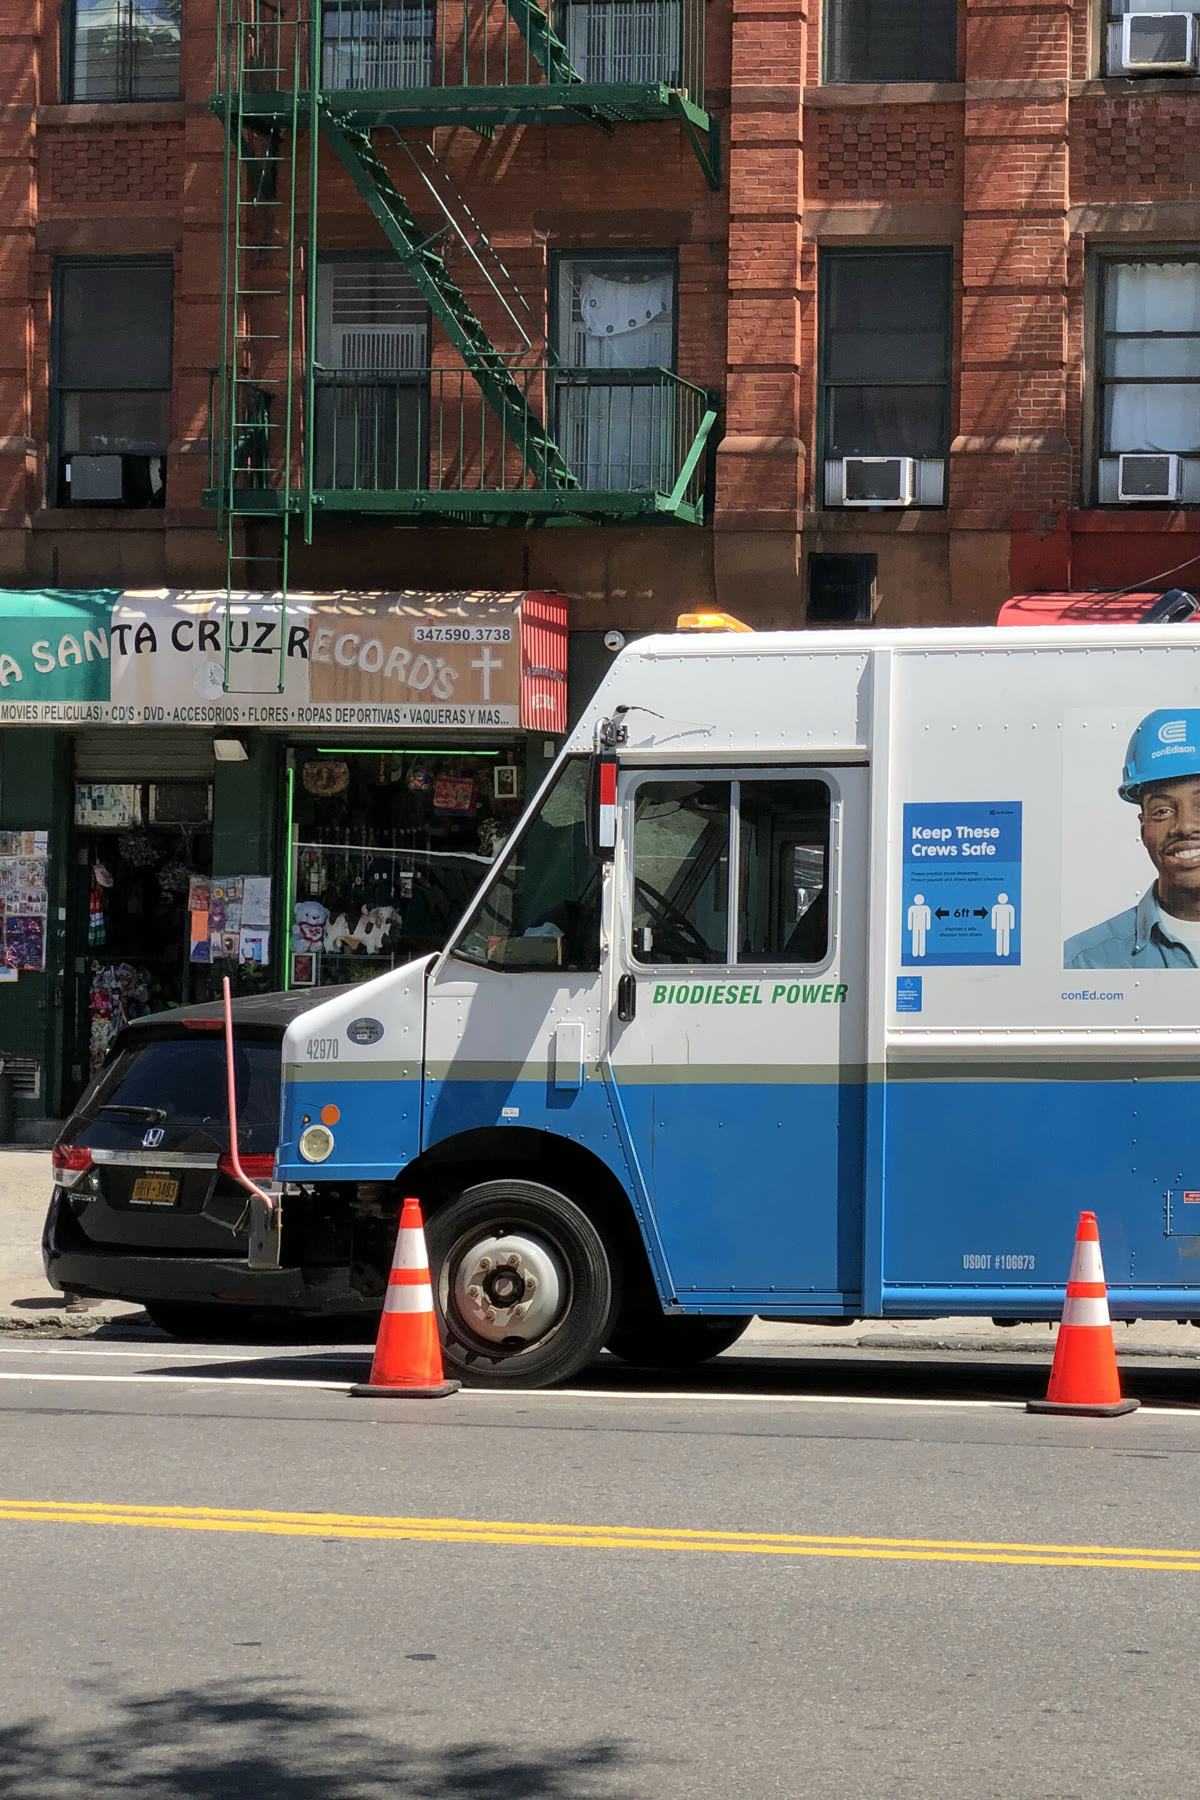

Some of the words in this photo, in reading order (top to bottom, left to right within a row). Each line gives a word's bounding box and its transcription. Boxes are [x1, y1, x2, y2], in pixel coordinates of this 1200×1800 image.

[416, 628, 511, 642] 347.590.3738
[32, 621, 157, 674] SANTA
[171, 620, 277, 655] CRUZ
[287, 625, 459, 700] RECORD'S
[1, 704, 39, 720] MOVIES
[40, 704, 103, 722] (PELICULAS)
[111, 705, 135, 721] CD'S
[143, 706, 165, 721] DVD
[172, 706, 239, 722] ACCESORIOS
[249, 706, 289, 722] FLORES
[297, 706, 333, 723] ROPAS
[335, 707, 401, 724] DEPORTIVAS
[409, 708, 466, 725] VAQUERAS
[468, 709, 475, 725] Y
[477, 709, 509, 725] MAS...
[1151, 745, 1196, 759] conEdison
[911, 826, 953, 842] Keep
[955, 825, 1000, 839] These
[911, 843, 958, 857] Crews
[961, 841, 997, 856] Safe
[953, 907, 970, 918] 6ft
[652, 984, 763, 1004] BIODIESEL
[771, 984, 849, 1004] POWER
[1061, 990, 1124, 1000] conEd.com
[306, 1039, 339, 1059] 42970
[963, 1254, 992, 1270] USDOT
[994, 1254, 1035, 1270] #106673
